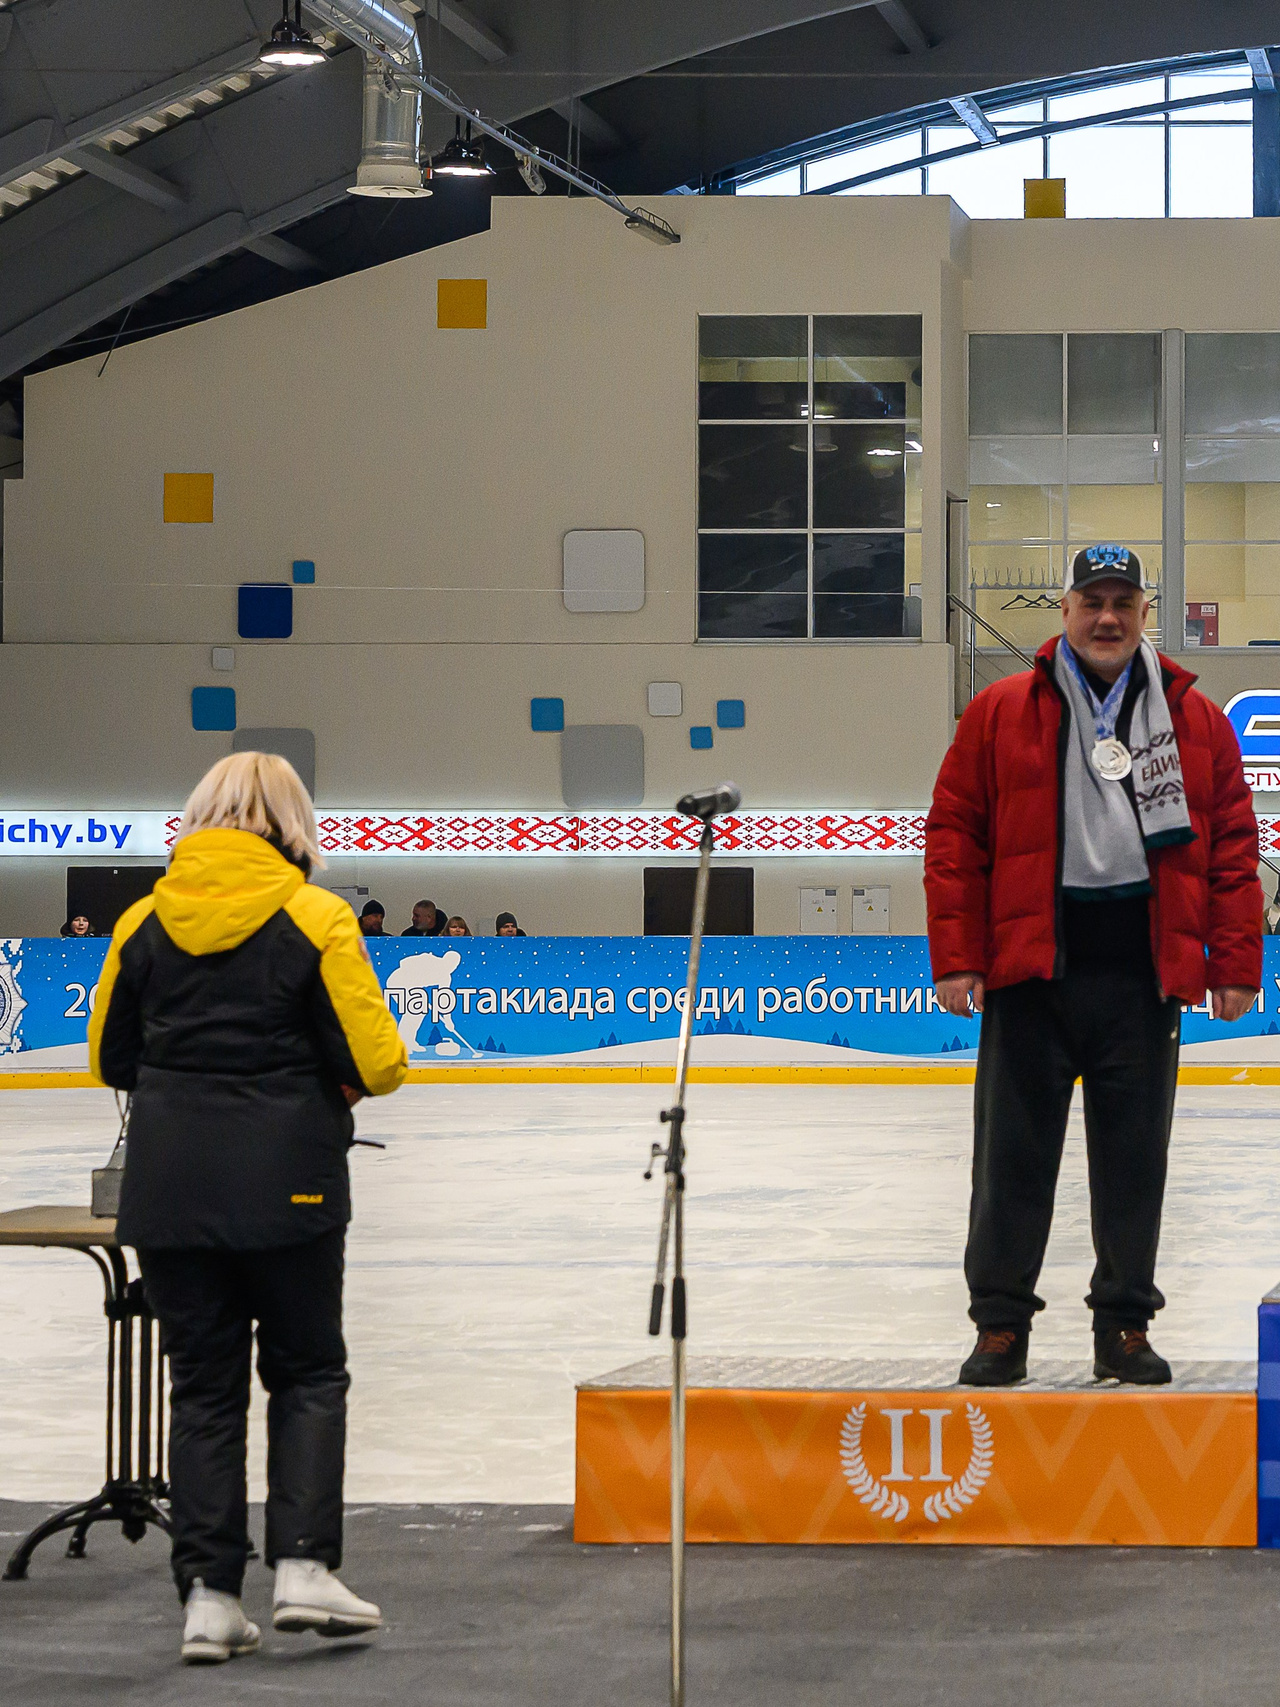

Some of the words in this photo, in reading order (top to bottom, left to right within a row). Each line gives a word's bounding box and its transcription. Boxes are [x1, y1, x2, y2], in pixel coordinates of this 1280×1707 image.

[383, 986, 616, 1023] партакиада
[626, 986, 746, 1023] среди
[757, 976, 984, 1023] работник
[880, 1408, 953, 1482] II
